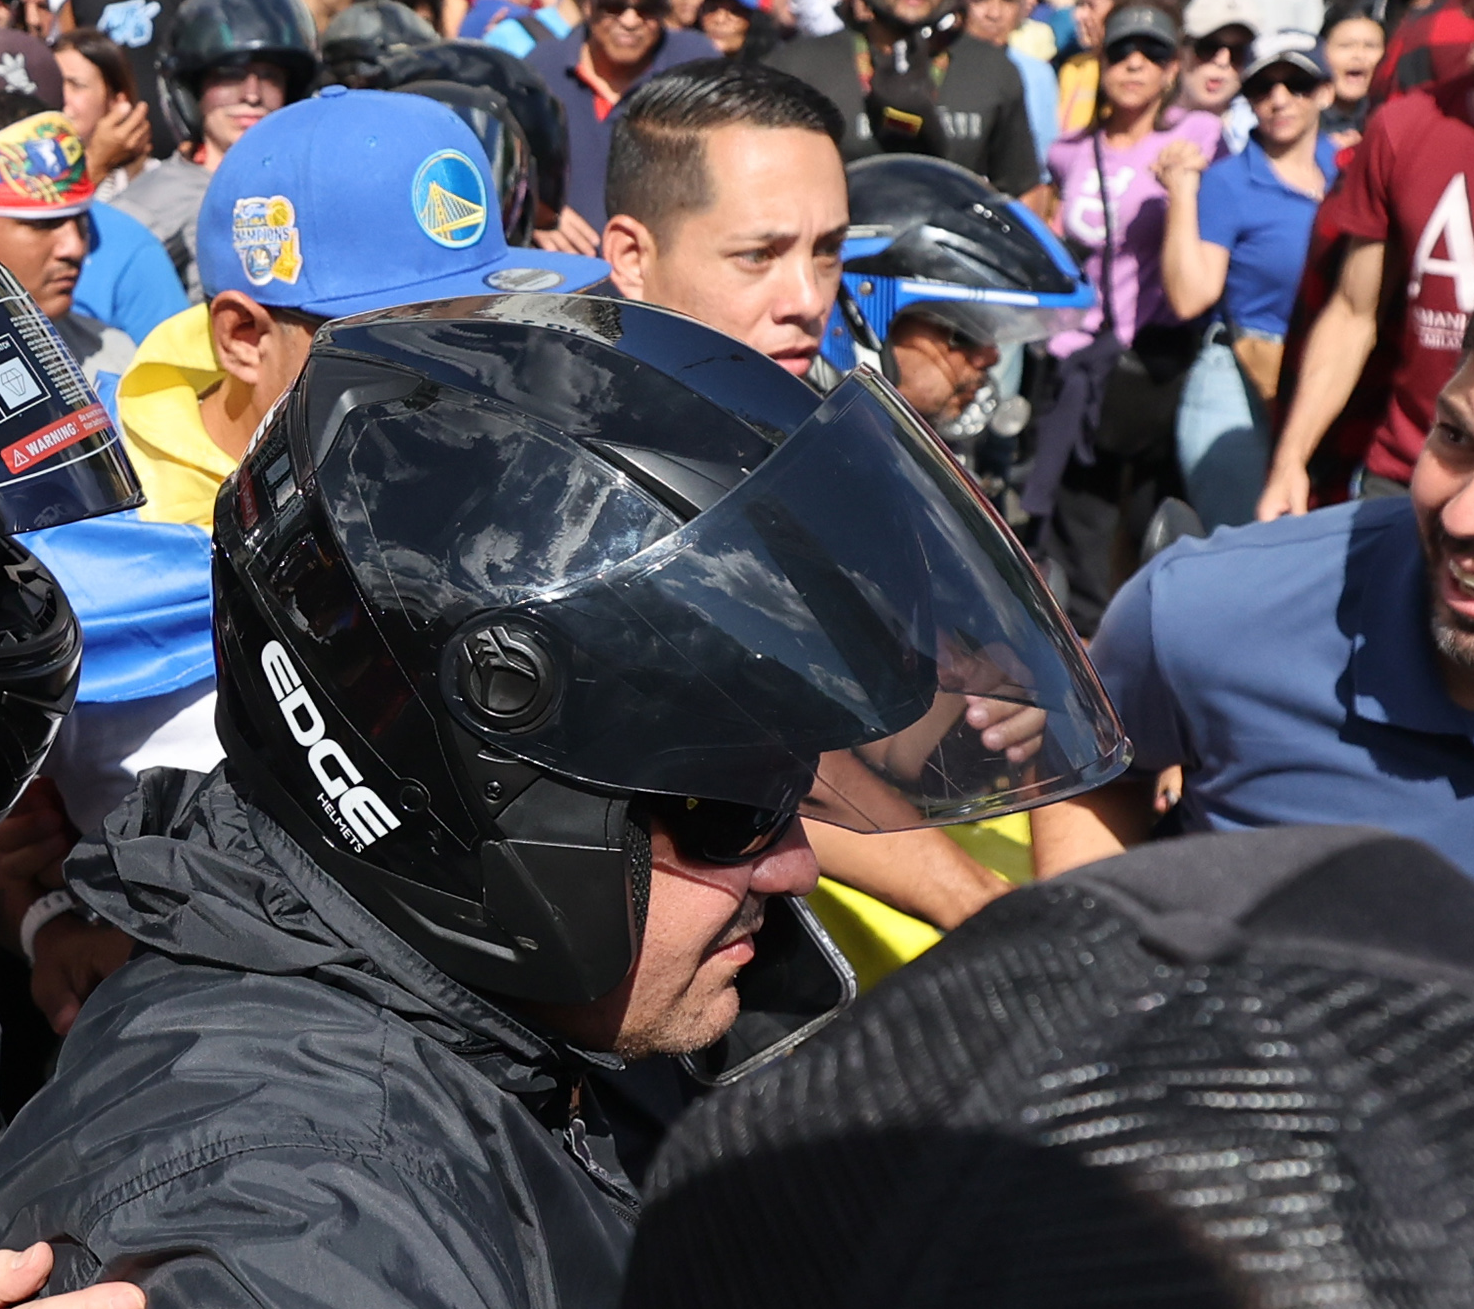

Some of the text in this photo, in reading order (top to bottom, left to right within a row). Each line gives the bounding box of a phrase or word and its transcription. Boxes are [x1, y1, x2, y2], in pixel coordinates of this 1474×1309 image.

[24, 421, 80, 457] WARNING!
[261, 640, 402, 846] EDGE
[316, 792, 365, 854] HELMETS
